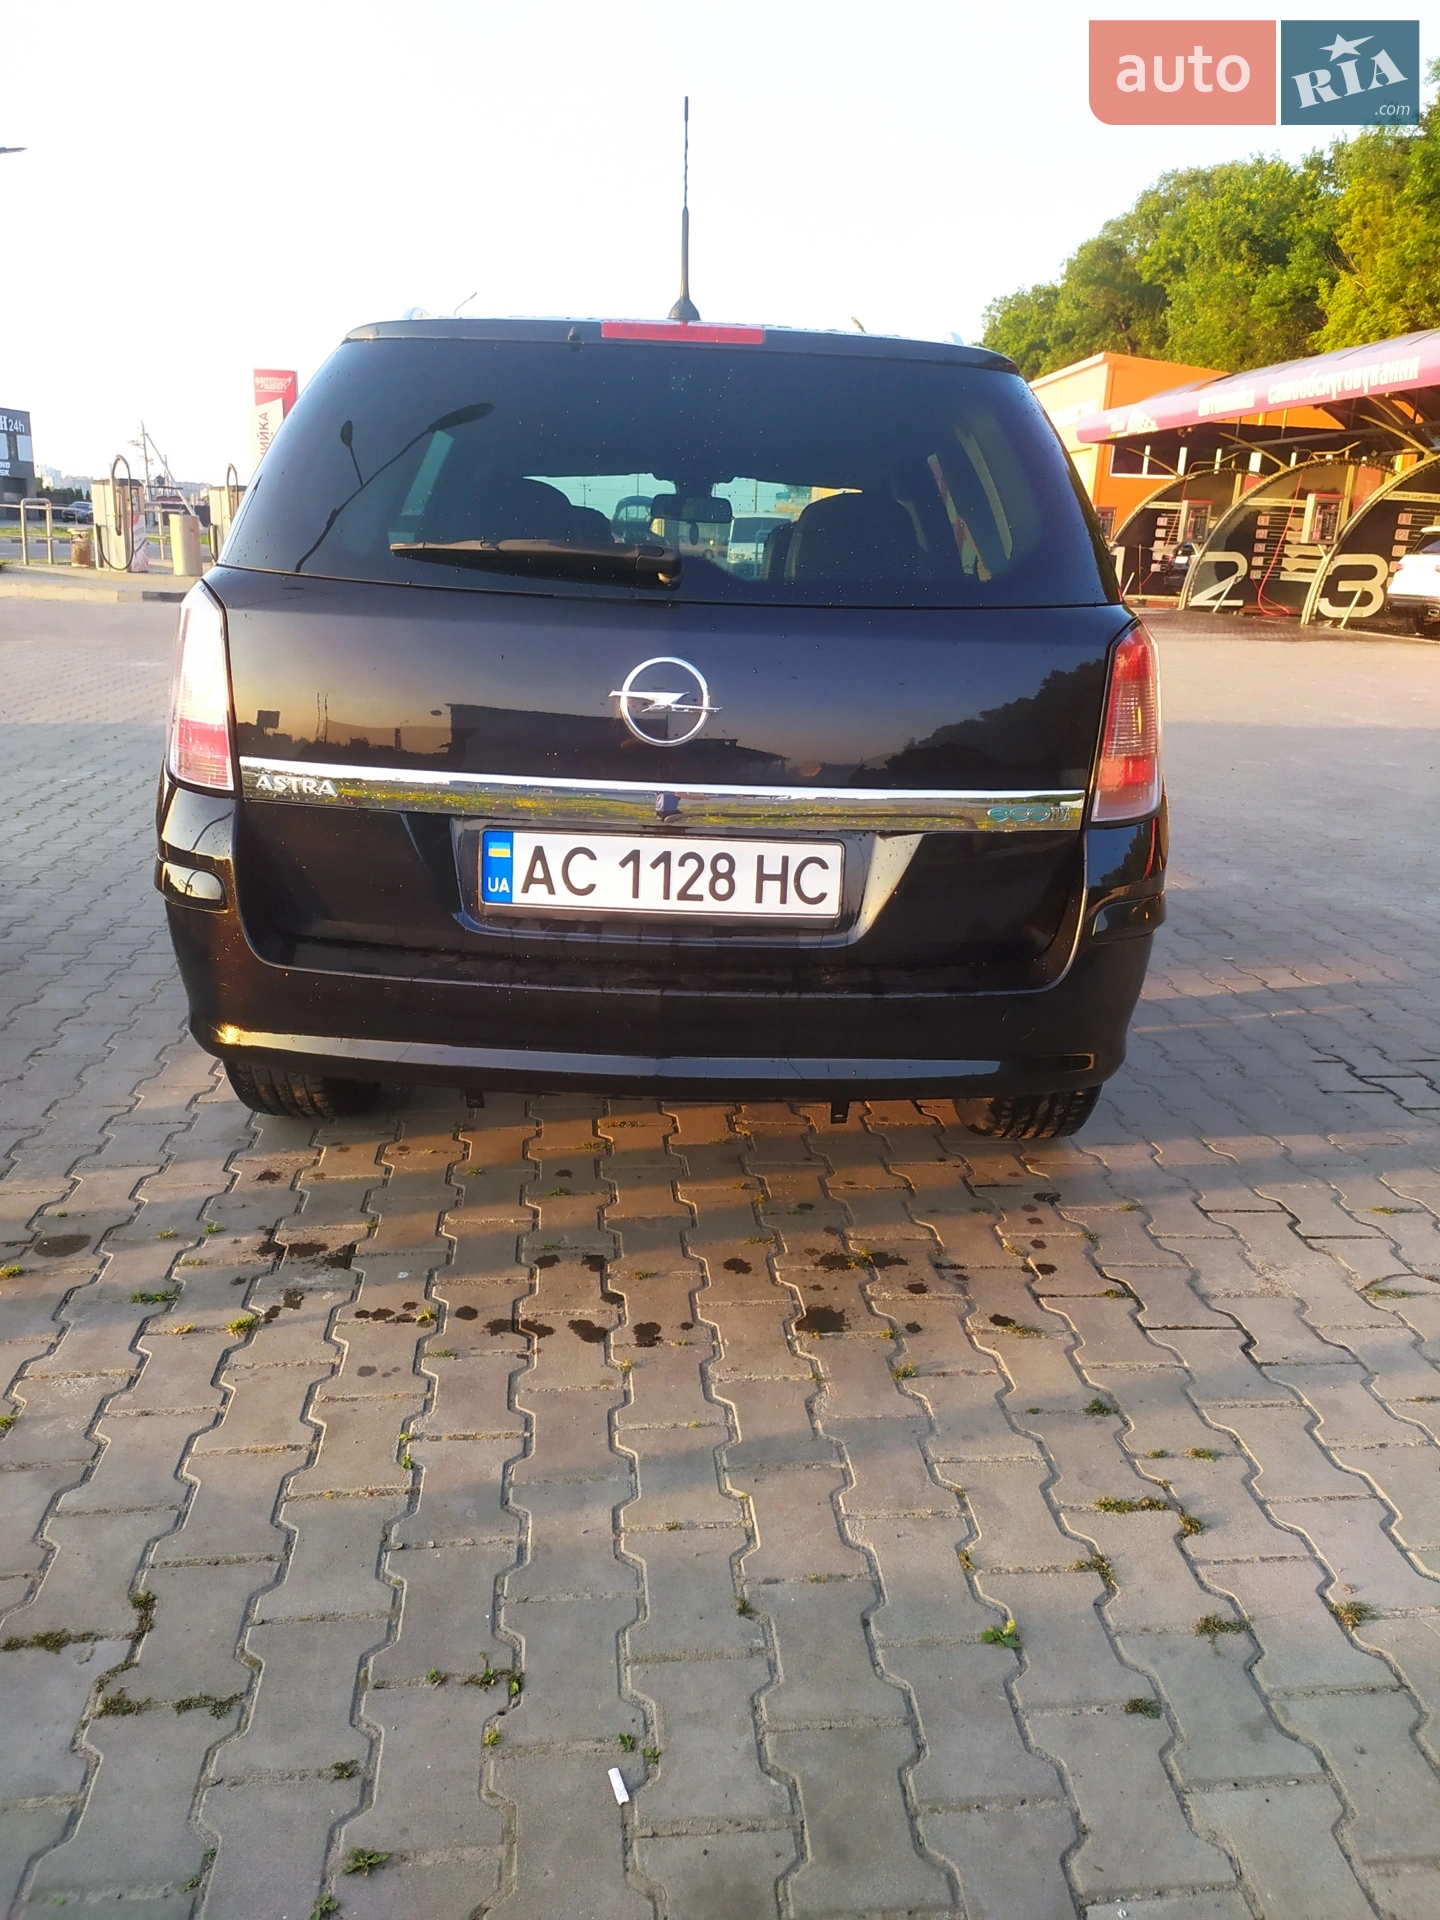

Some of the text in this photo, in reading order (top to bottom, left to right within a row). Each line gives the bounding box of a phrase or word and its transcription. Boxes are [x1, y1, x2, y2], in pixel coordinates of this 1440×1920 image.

[9, 419, 25, 433] 24h
[257, 412, 269, 456] ИЙКА
[1111, 546, 1126, 588] 1
[1189, 551, 1248, 607] 2
[1317, 553, 1389, 618] 3
[256, 774, 338, 797] ASTRA
[488, 877, 510, 893] UA
[520, 845, 829, 905] AC 1128 HC
